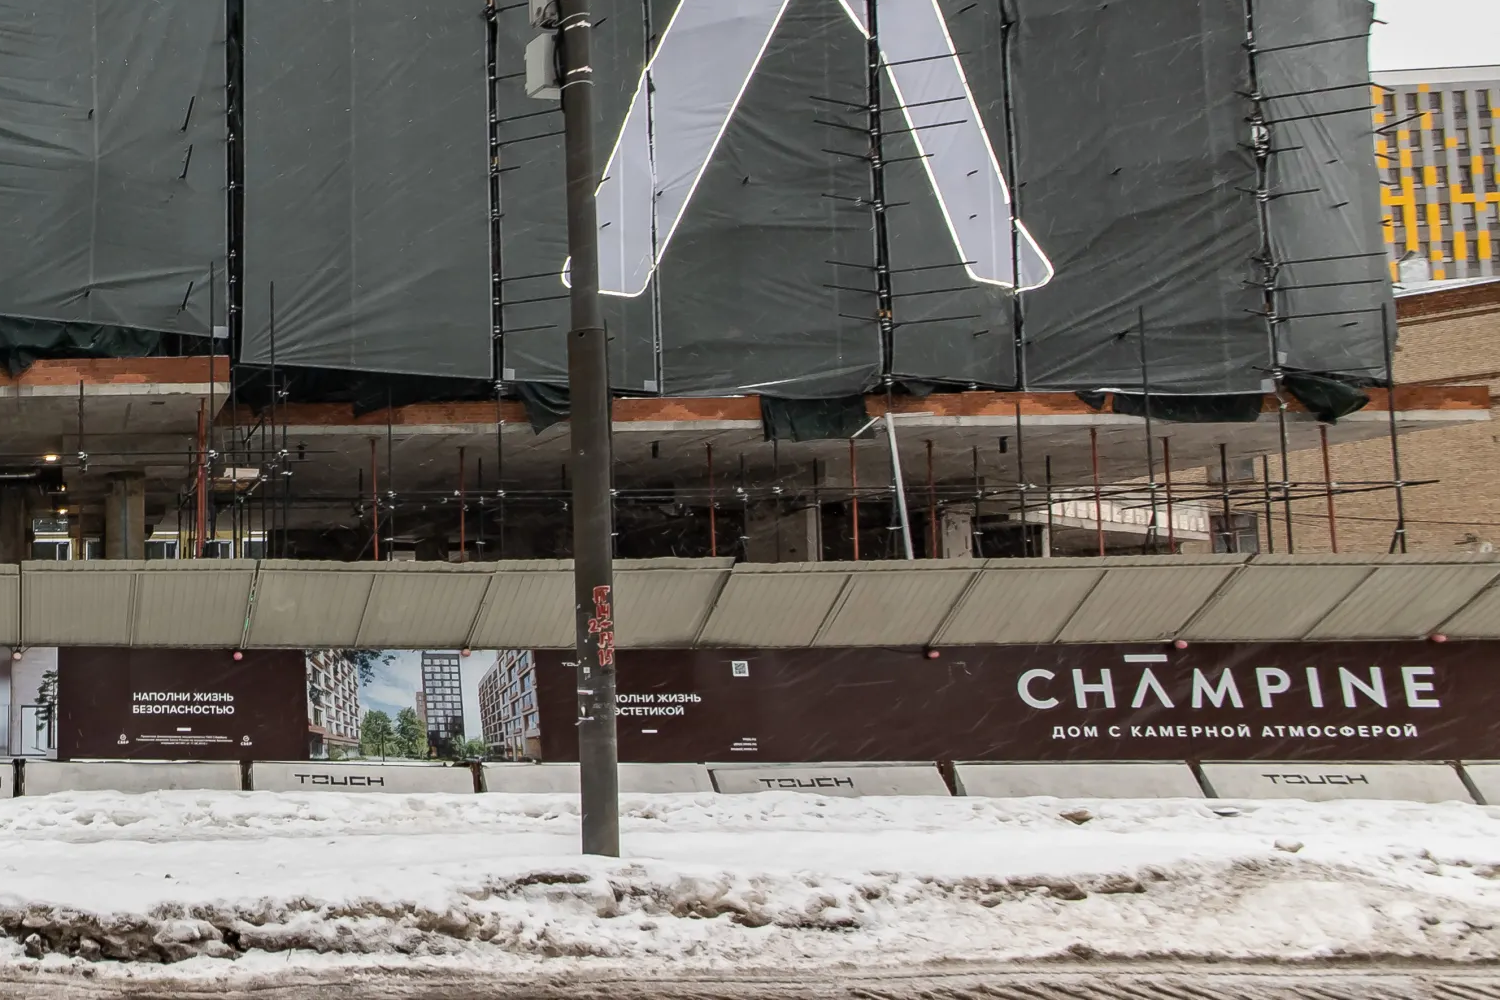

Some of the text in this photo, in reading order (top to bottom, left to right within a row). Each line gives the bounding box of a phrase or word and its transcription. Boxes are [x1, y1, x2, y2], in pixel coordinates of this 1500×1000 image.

[132, 691, 235, 702] НАПОЛНИ ЖИЗНЬ
[657, 693, 702, 703] ЖИЗНЬ
[132, 704, 235, 715] БЕЗОПАСНОСТЬЮ
[1052, 723, 1419, 739] ДОМ С КАМЕРНОЙ АТМОСФЕРОЙ
[294, 773, 385, 787] TOUCH
[758, 777, 854, 789] TOUCH
[1261, 774, 1370, 785] TOUCH
